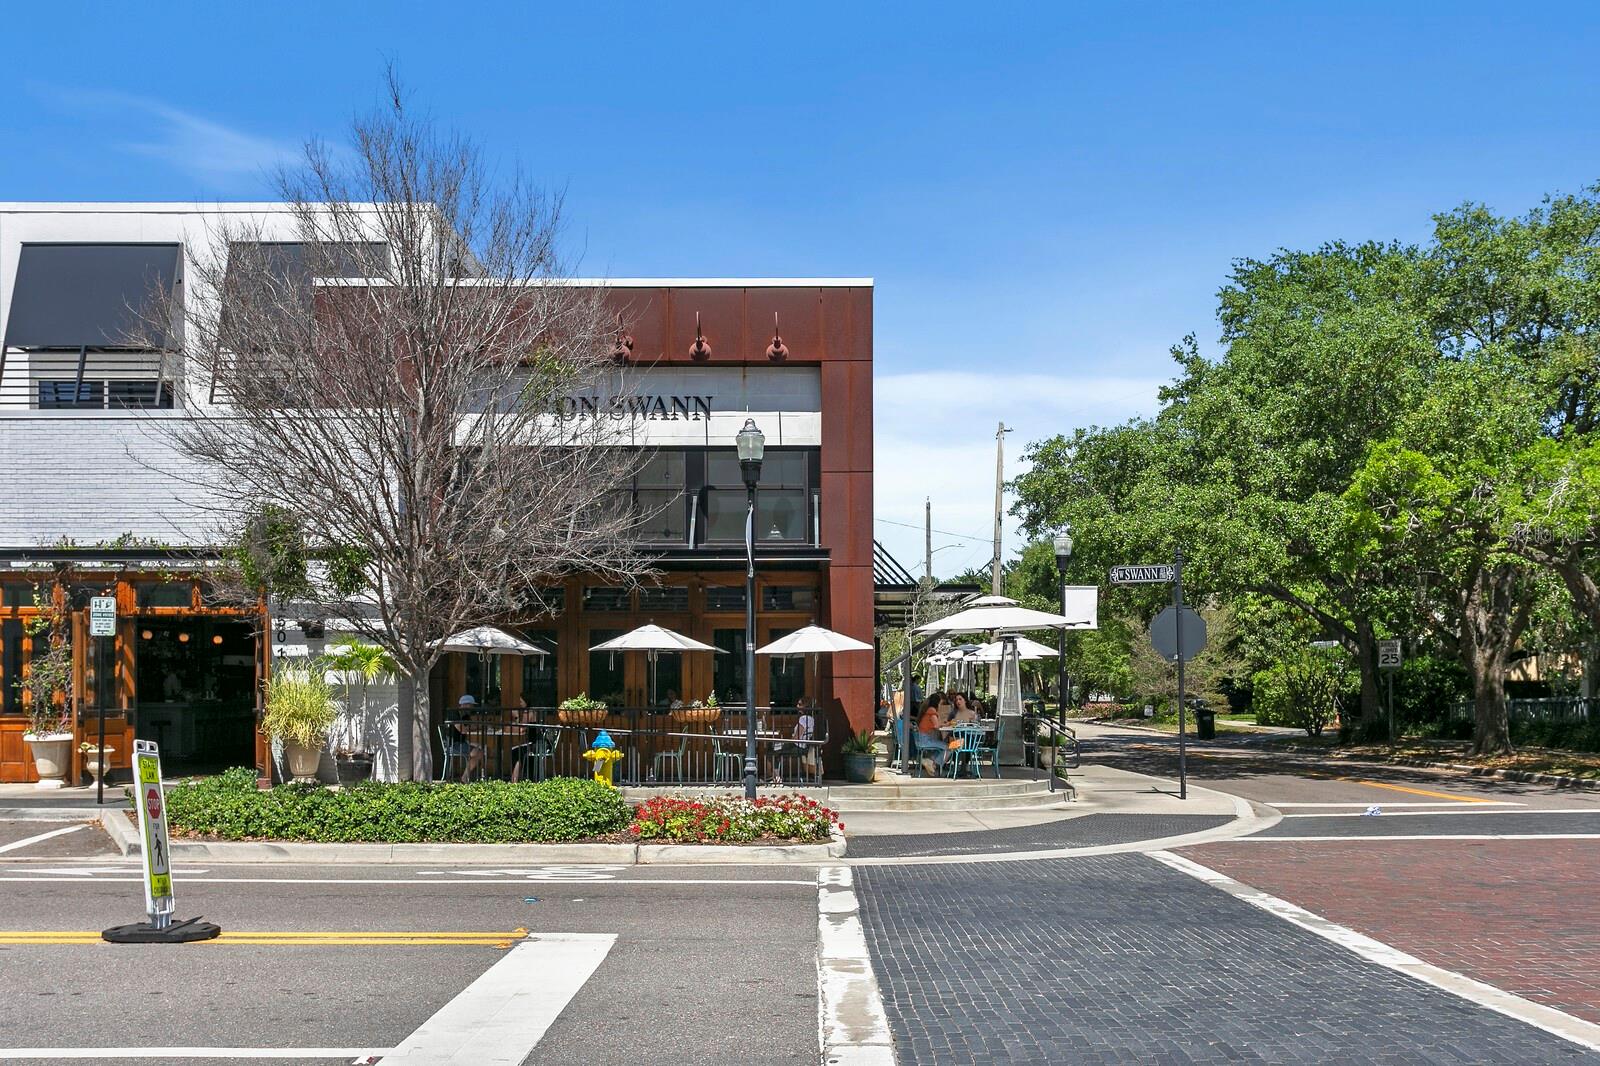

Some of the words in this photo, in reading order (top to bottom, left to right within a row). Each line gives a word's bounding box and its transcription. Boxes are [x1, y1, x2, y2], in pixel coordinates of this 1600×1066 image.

[609, 395, 713, 421] SWANN
[1119, 570, 1124, 578] W
[1125, 568, 1158, 580] SWANN
[1381, 654, 1398, 664] 25
[142, 759, 157, 770] STATE
[145, 771, 156, 780] LAW
[147, 798, 160, 810] STOP
